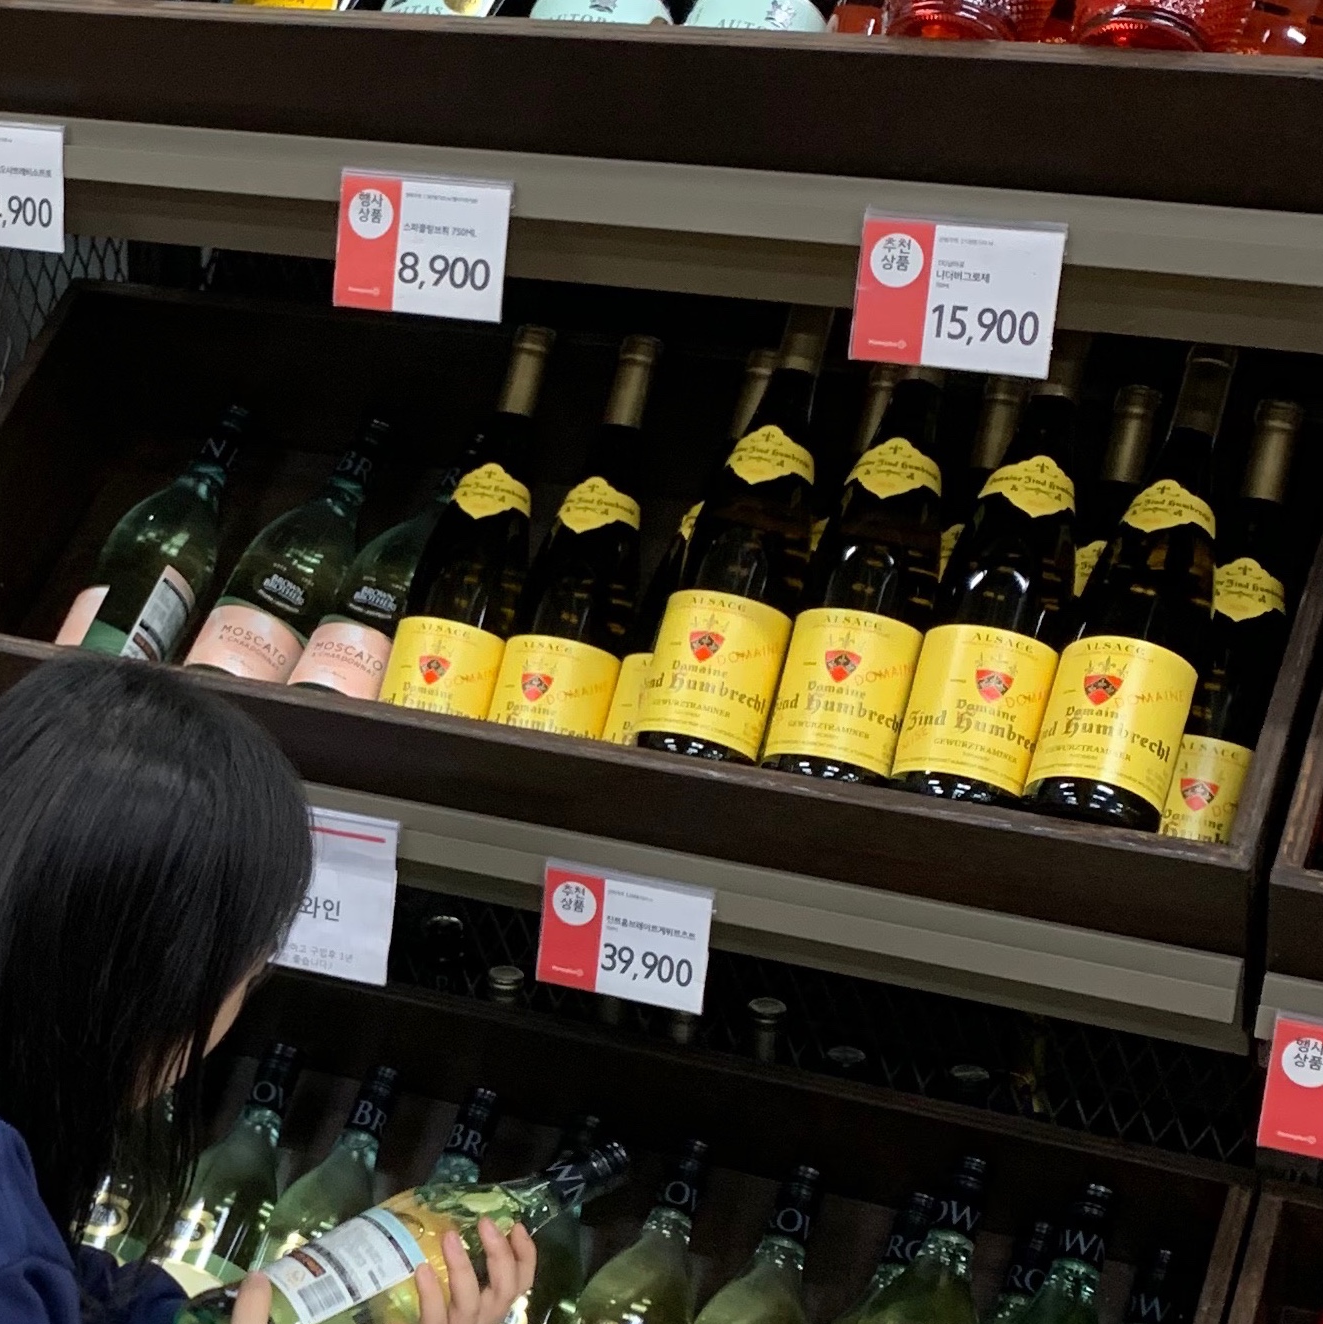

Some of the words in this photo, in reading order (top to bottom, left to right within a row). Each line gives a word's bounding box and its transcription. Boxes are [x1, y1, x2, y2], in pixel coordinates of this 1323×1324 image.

[358, 191, 383, 208] 행사
[358, 208, 383, 224] 상품
[882, 238, 912, 255] 추천
[397, 251, 491, 291] 8,900
[880, 254, 910, 272] 상품
[931, 303, 1040, 347] 15,900
[220, 624, 287, 667] MOSCATO
[972, 631, 1034, 655] ALSACE
[315, 641, 384, 672] MOSCATO
[1066, 705, 1126, 720] Domain
[561, 883, 586, 900] 추천
[299, 896, 341, 922] 와인
[560, 897, 585, 913] 상품
[600, 942, 693, 987] 39,900
